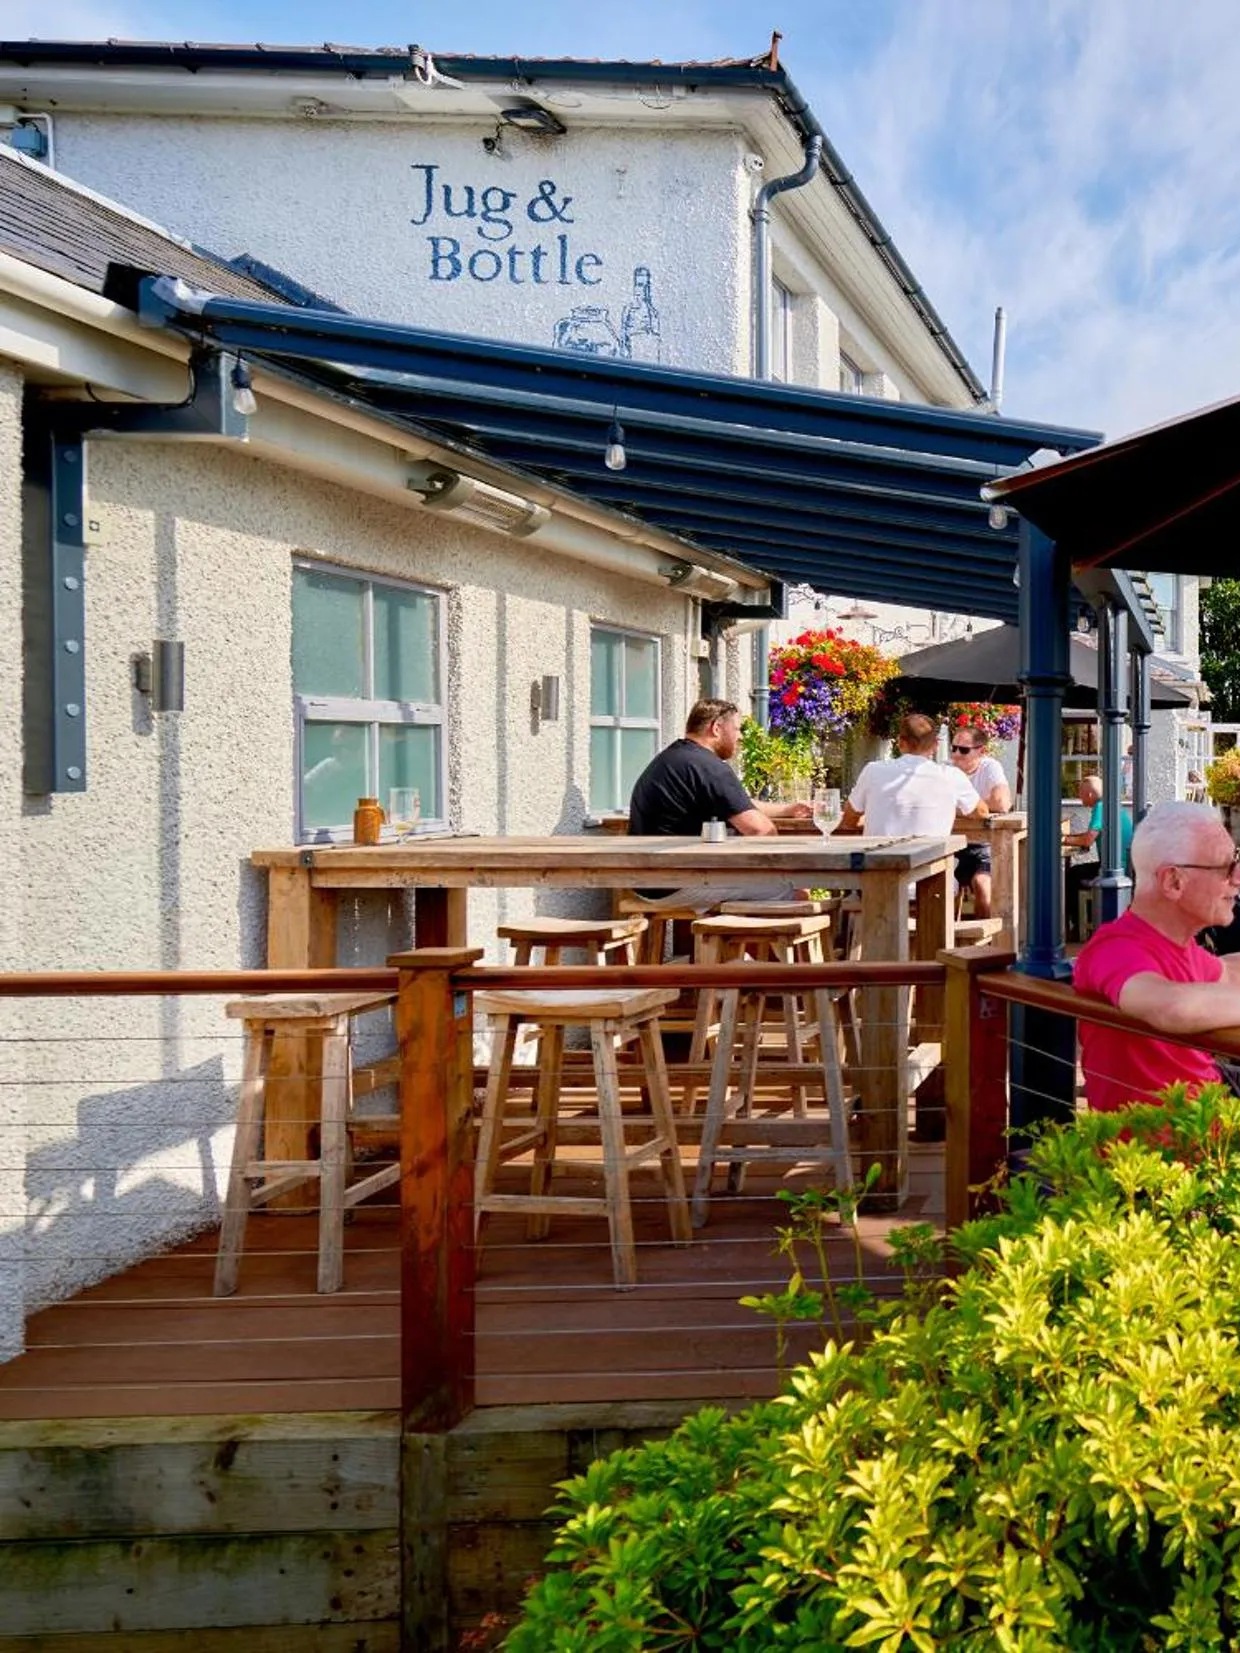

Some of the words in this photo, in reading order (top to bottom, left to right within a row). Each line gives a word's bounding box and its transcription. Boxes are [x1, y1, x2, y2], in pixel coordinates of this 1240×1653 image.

[411, 164, 516, 241] Jug
[527, 179, 574, 224] &
[426, 234, 602, 285] Bottle
